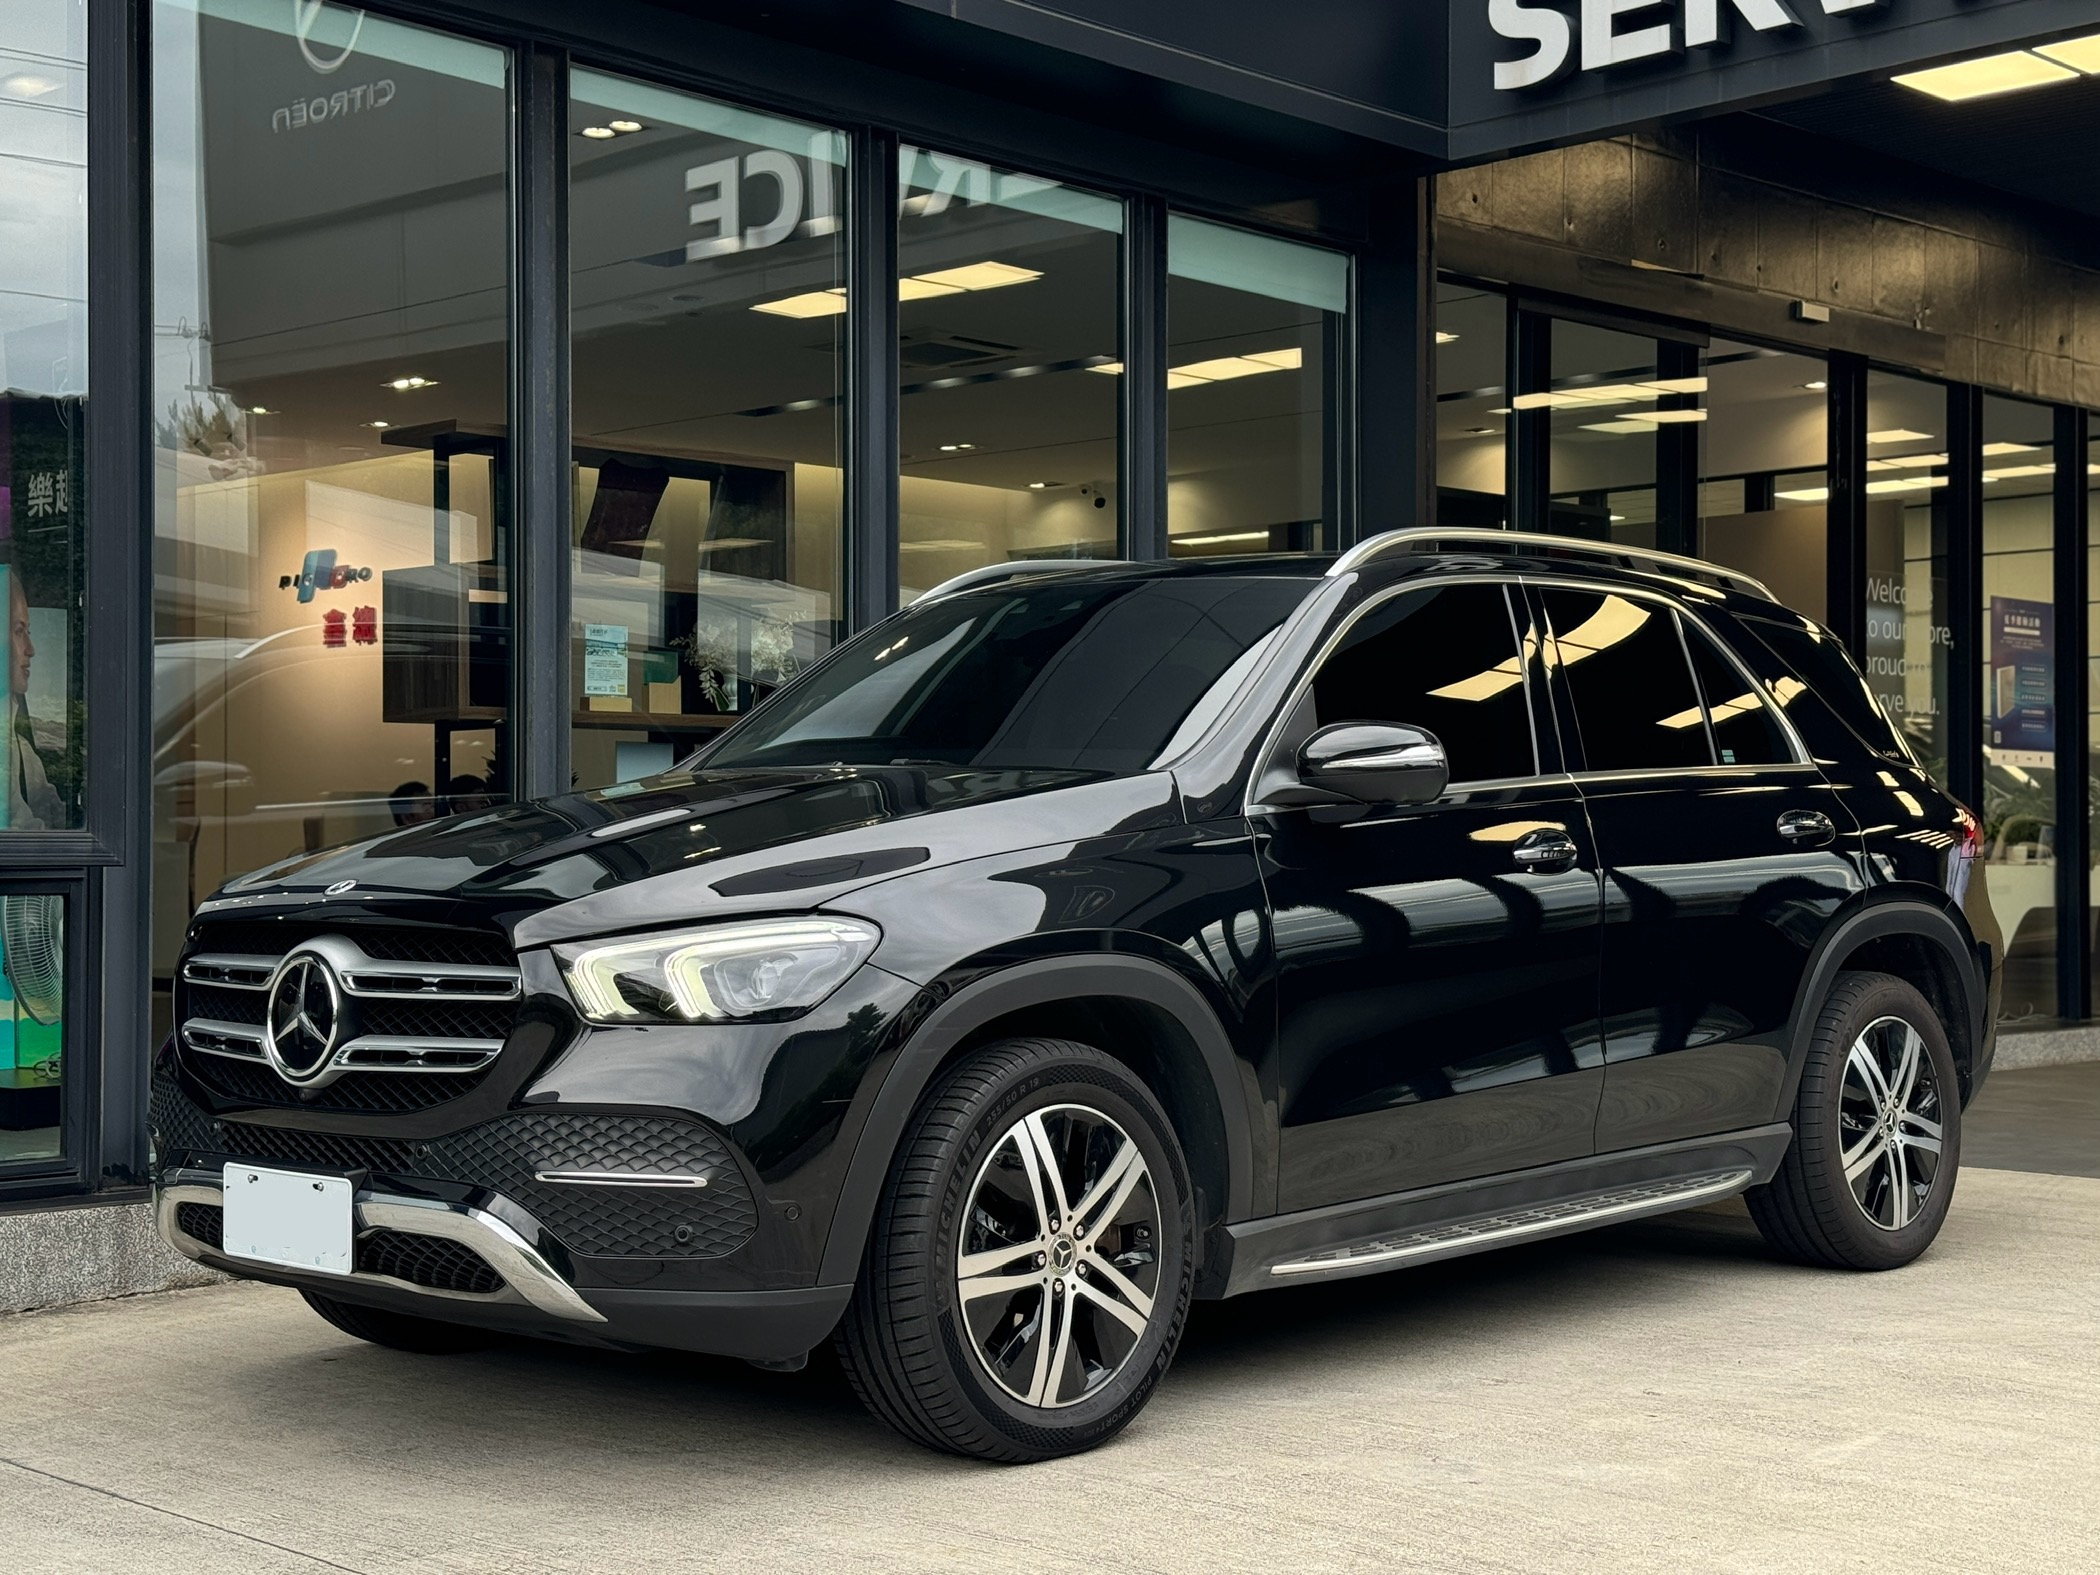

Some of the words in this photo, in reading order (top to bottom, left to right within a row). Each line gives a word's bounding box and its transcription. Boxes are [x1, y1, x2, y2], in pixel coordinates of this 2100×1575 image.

[986, 1091, 1017, 1126] 255/50
[1020, 1085, 1026, 1094] R
[1029, 1078, 1040, 1088] 19
[936, 1130, 981, 1270] MICHELIN
[1155, 1241, 1193, 1371] MICHELIN
[1131, 1375, 1153, 1408] PILOT
[1100, 1404, 1129, 1432] SPORT
